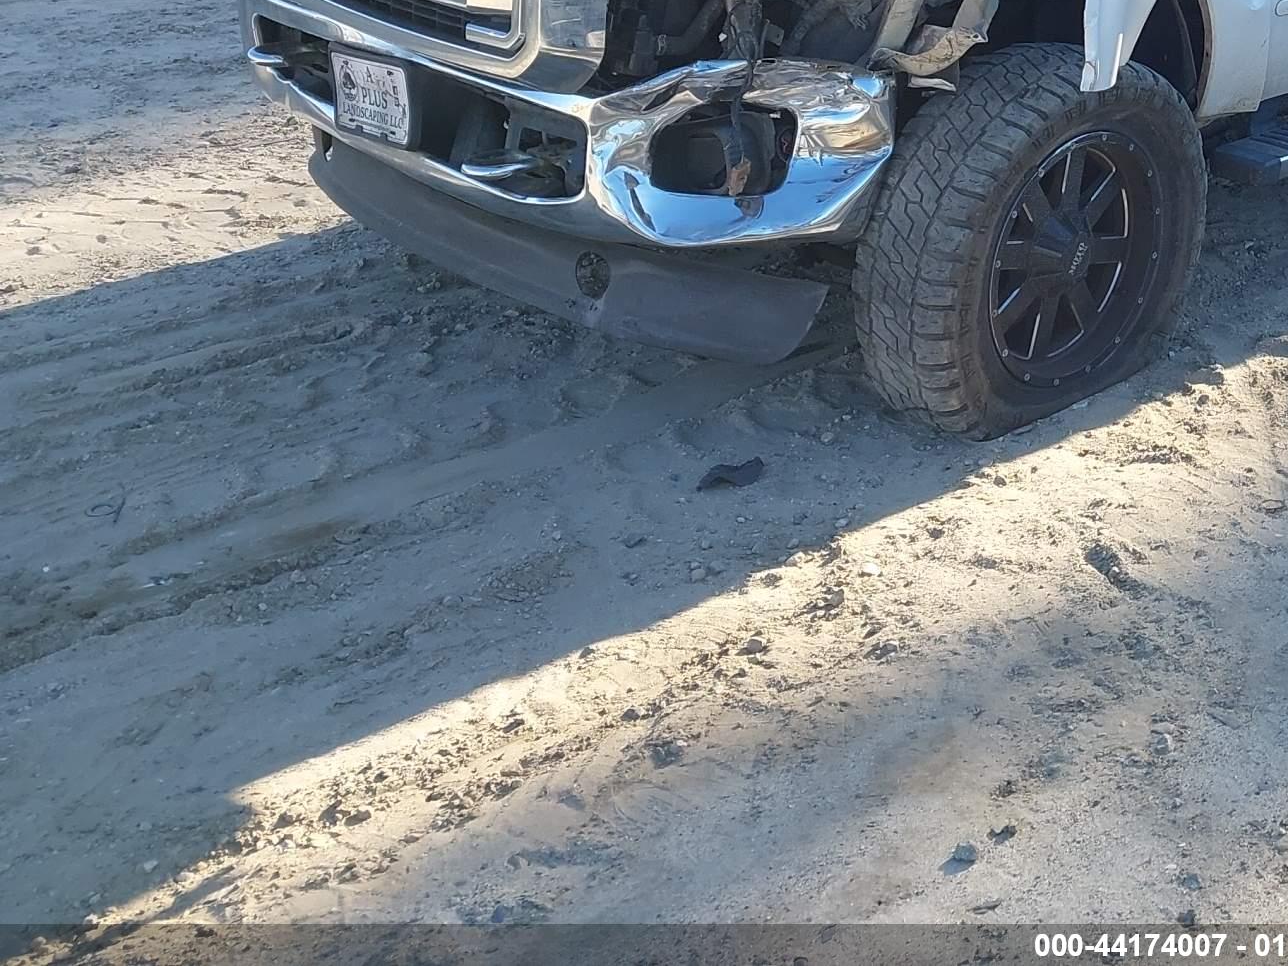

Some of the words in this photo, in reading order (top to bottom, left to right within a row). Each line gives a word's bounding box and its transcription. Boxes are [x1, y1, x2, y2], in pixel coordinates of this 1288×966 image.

[365, 66, 375, 84] A
[361, 87, 388, 109] PLUS
[342, 101, 389, 126] LANDSCAPING
[389, 114, 404, 130] LLC
